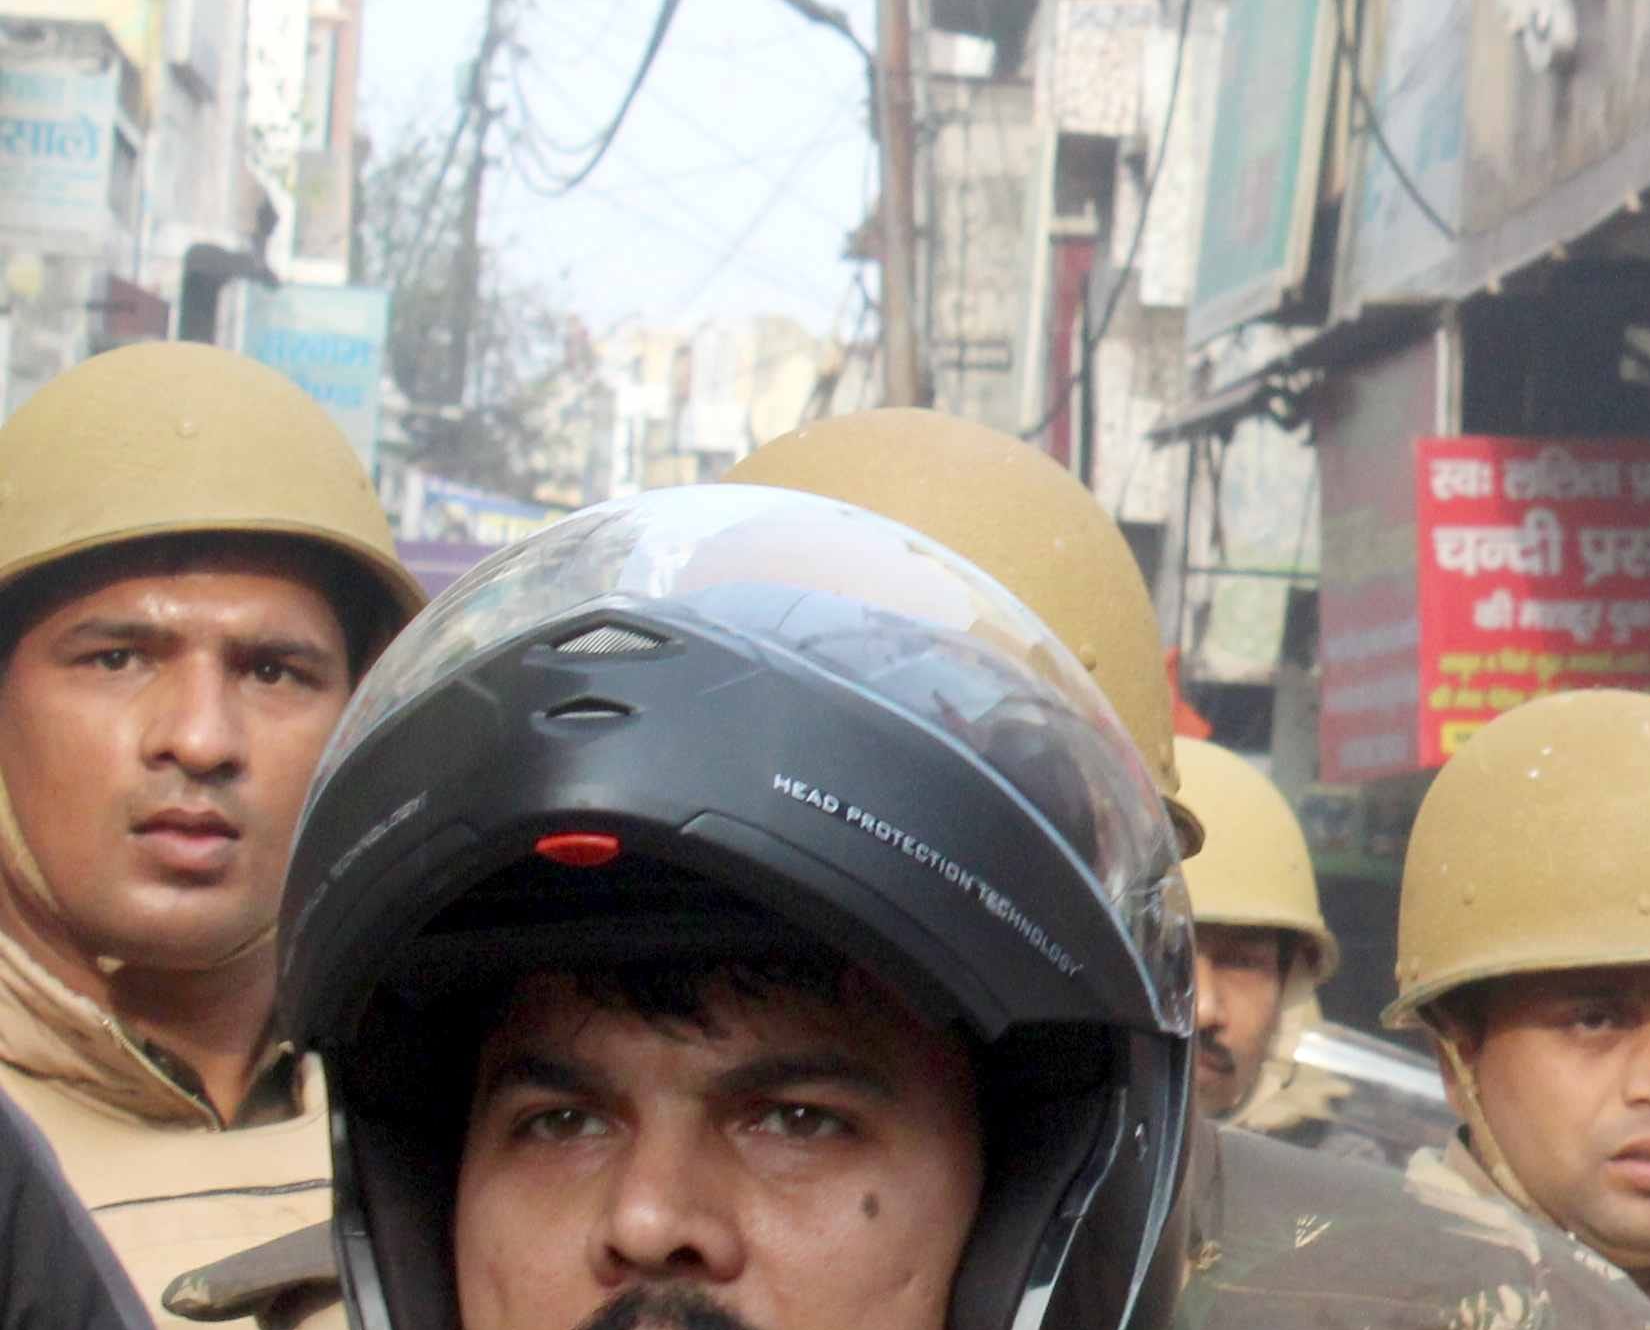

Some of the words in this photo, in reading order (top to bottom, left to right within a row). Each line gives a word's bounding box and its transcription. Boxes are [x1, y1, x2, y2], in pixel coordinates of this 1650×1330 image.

[773, 773, 840, 815] HEAD
[845, 805, 972, 893] PROTECTION
[976, 883, 1086, 978] TECHNOLOGY
